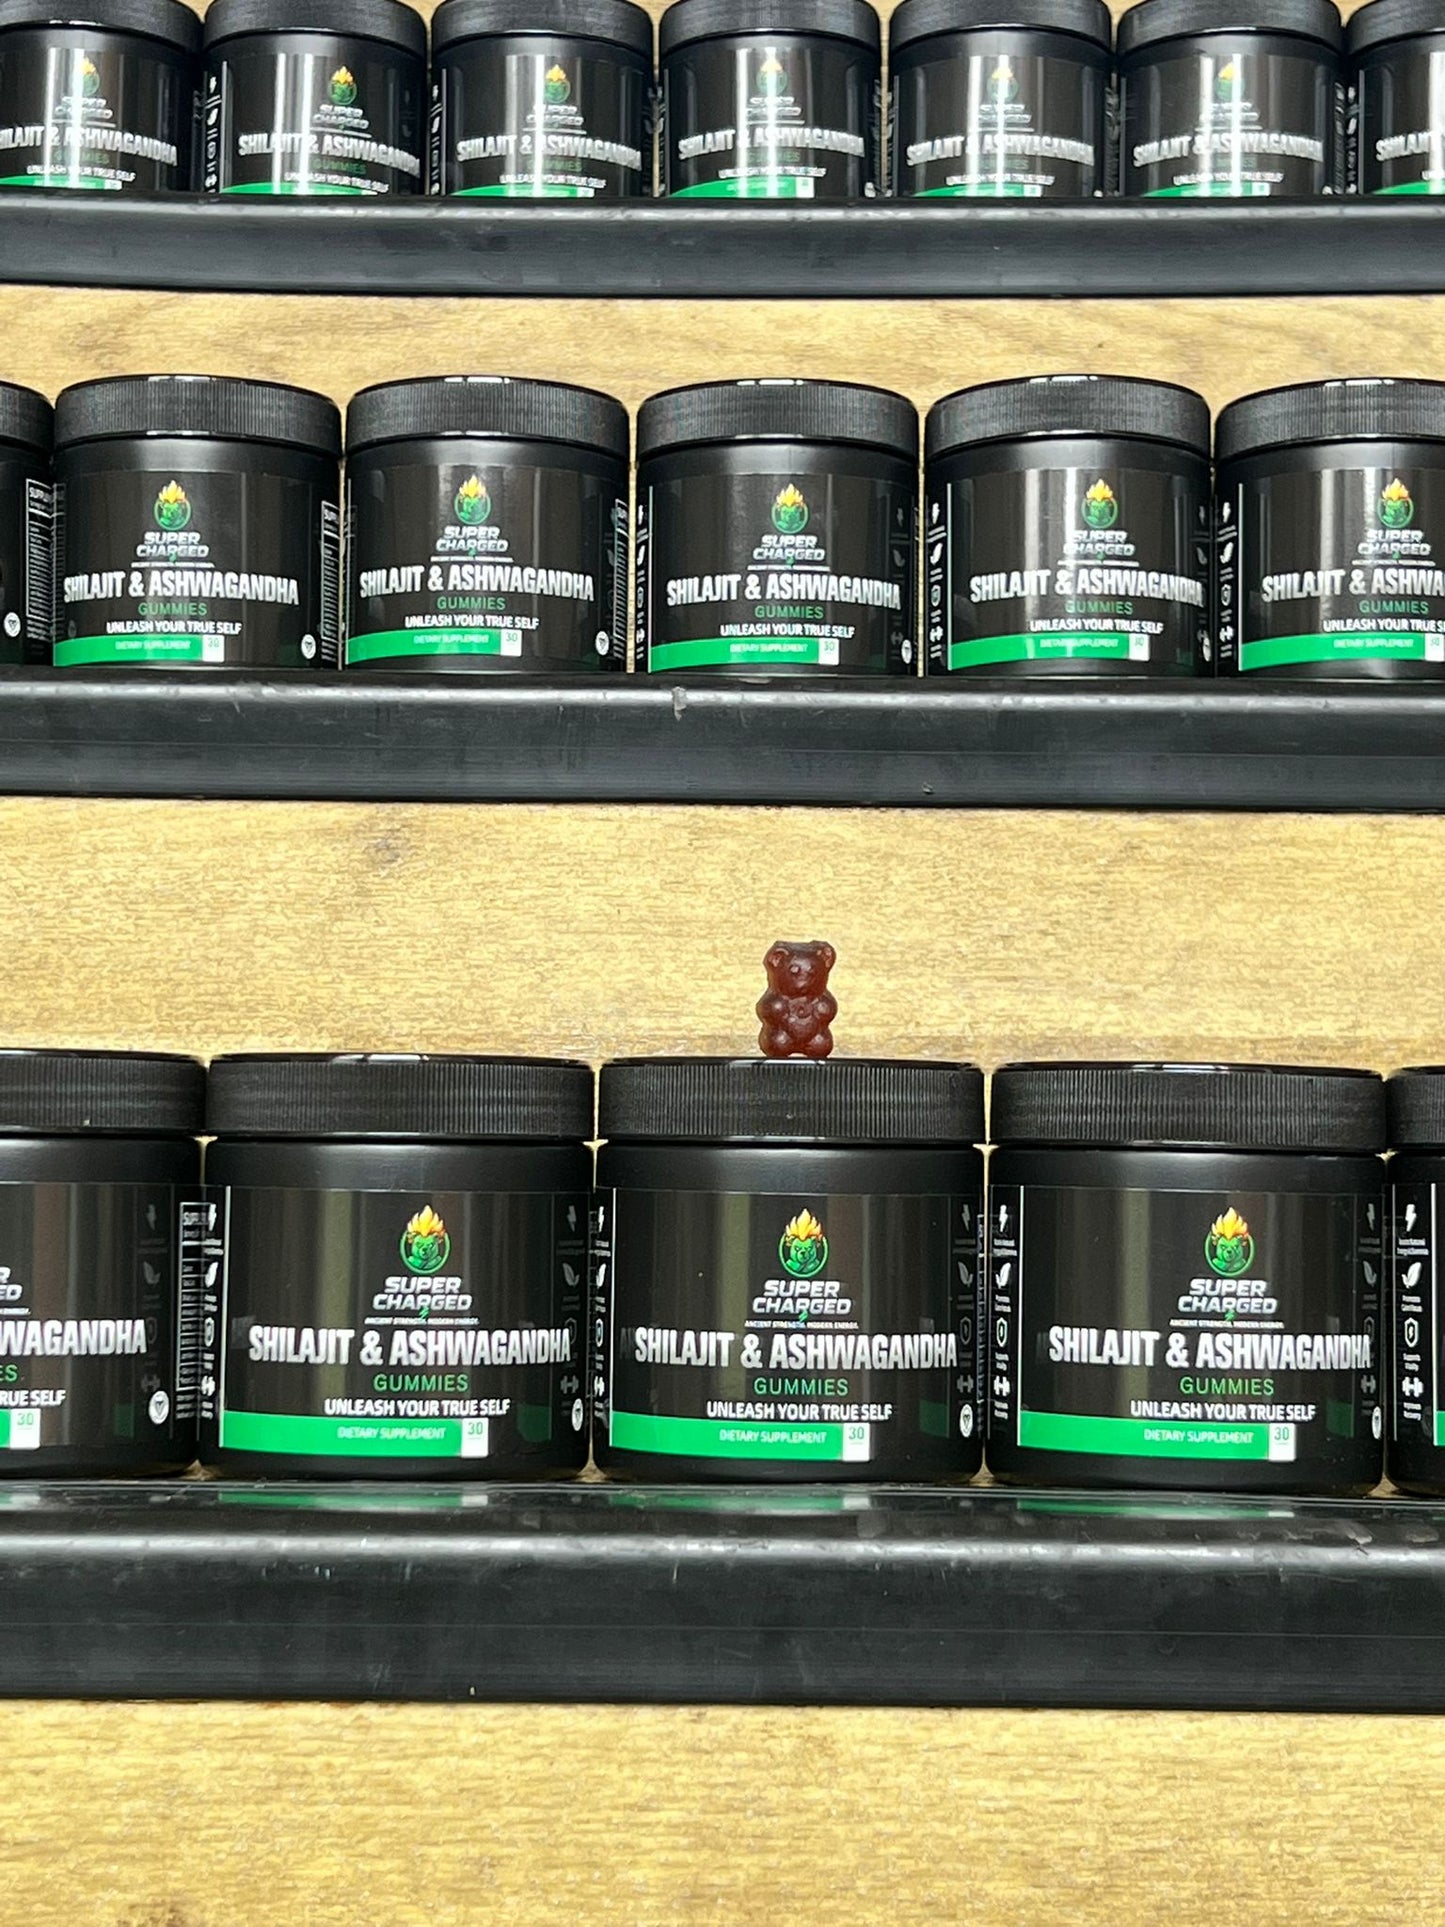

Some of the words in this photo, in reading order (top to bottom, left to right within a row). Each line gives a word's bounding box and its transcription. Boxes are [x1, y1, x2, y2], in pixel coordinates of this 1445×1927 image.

[144, 531, 201, 545] SUPER
[443, 525, 500, 539] SUPER
[1073, 529, 1128, 544] SUPER
[1366, 529, 1424, 543] SUPER
[435, 538, 509, 552] CHARGED
[761, 534, 818, 548] SUPER
[1063, 543, 1136, 556] CHARGED
[1357, 543, 1432, 556] CHARGED
[136, 544, 210, 557] CHARGED
[752, 548, 825, 561] CHARGED
[63, 571, 126, 602] SHILAJIT
[128, 571, 145, 597] &
[150, 570, 299, 605] ASHWAGANDHA
[360, 564, 425, 598] SHILAJIT
[427, 565, 444, 591] &
[448, 564, 594, 601] ASHWAGANDHA
[970, 569, 1051, 603] SHILAJIT
[1055, 570, 1073, 596] &
[1077, 569, 1203, 607] ASHWAGANDHA
[1262, 569, 1345, 602] SHILAJIT
[1349, 569, 1366, 595] &
[1371, 568, 1445, 597] ASHWA
[666, 574, 741, 606] SHILAJIT
[744, 574, 761, 600] &
[766, 573, 901, 610] ASHWAGANDHA
[138, 602, 207, 616] GUMMIES
[437, 597, 506, 610] GUMMIES
[754, 605, 824, 619] GUMMIES
[1065, 601, 1133, 615] GUMMIES
[1359, 600, 1429, 614] GUMMIES
[106, 620, 155, 634] UNLEASH
[156, 621, 187, 633] YOUR
[187, 621, 215, 634] TRUE
[216, 622, 242, 635] SELF
[405, 614, 451, 628] UNLEASH
[453, 614, 484, 627] YOUR
[484, 615, 514, 628] TRUE
[514, 616, 539, 630] SELF
[1030, 618, 1081, 632] UNLEASH
[1082, 619, 1115, 631] YOUR
[1115, 619, 1141, 632] TRUE
[1141, 621, 1164, 634] SELF
[1322, 618, 1377, 632] UNLEASH
[1378, 618, 1410, 631] YOUR
[1411, 619, 1436, 632] TRUE
[720, 624, 771, 636] UNLEASH
[772, 624, 803, 636] YOUR
[804, 625, 831, 637] TRUE
[833, 626, 855, 638] SELF
[384, 1276, 461, 1294] SUPER
[763, 1280, 840, 1298] SUPER
[1189, 1278, 1266, 1297] SUPER
[372, 1294, 473, 1310] CHARGED
[752, 1297, 852, 1314] CHARGED
[1178, 1296, 1277, 1314] CHARGED
[249, 1325, 355, 1364] SHILAJIT
[360, 1330, 383, 1365] &
[389, 1328, 571, 1366] ASHWAGANDHA
[634, 1326, 735, 1367] SHILAJIT
[740, 1333, 763, 1368] &
[769, 1333, 957, 1370] ASHWAGANDHA
[1049, 1325, 1160, 1366] SHILAJIT
[1165, 1333, 1189, 1368] &
[1195, 1333, 1371, 1370] ASHWAGANDHA
[374, 1374, 469, 1392] GUMMIES
[754, 1377, 848, 1396] GUMMIES
[1180, 1376, 1274, 1396] GUMMIES
[29, 1390, 66, 1407] SELF
[324, 1398, 395, 1417] UNLEASH
[397, 1399, 440, 1416] YOUR
[441, 1399, 479, 1416] TRUE
[479, 1398, 511, 1416] SELF
[706, 1400, 775, 1420] UNLEASH
[777, 1402, 819, 1421] YOUR
[821, 1403, 859, 1421] TRUE
[860, 1404, 892, 1421] SELF
[1130, 1400, 1201, 1419] UNLEASH
[1203, 1401, 1247, 1420] YOUR
[1248, 1403, 1287, 1421] TRUE
[1286, 1404, 1316, 1422] SELF
[16, 1412, 34, 1426] 30
[337, 1426, 377, 1439] DIETARY
[379, 1426, 446, 1440] SUPPLEMENT
[467, 1421, 483, 1435] 30
[719, 1428, 758, 1442] DIETARY
[760, 1430, 826, 1444] SUPPLEMENT
[848, 1426, 864, 1440] 30
[1144, 1428, 1185, 1442] DIETARY
[1187, 1429, 1254, 1444] SUPPLEMENT
[1274, 1426, 1290, 1441] 30
